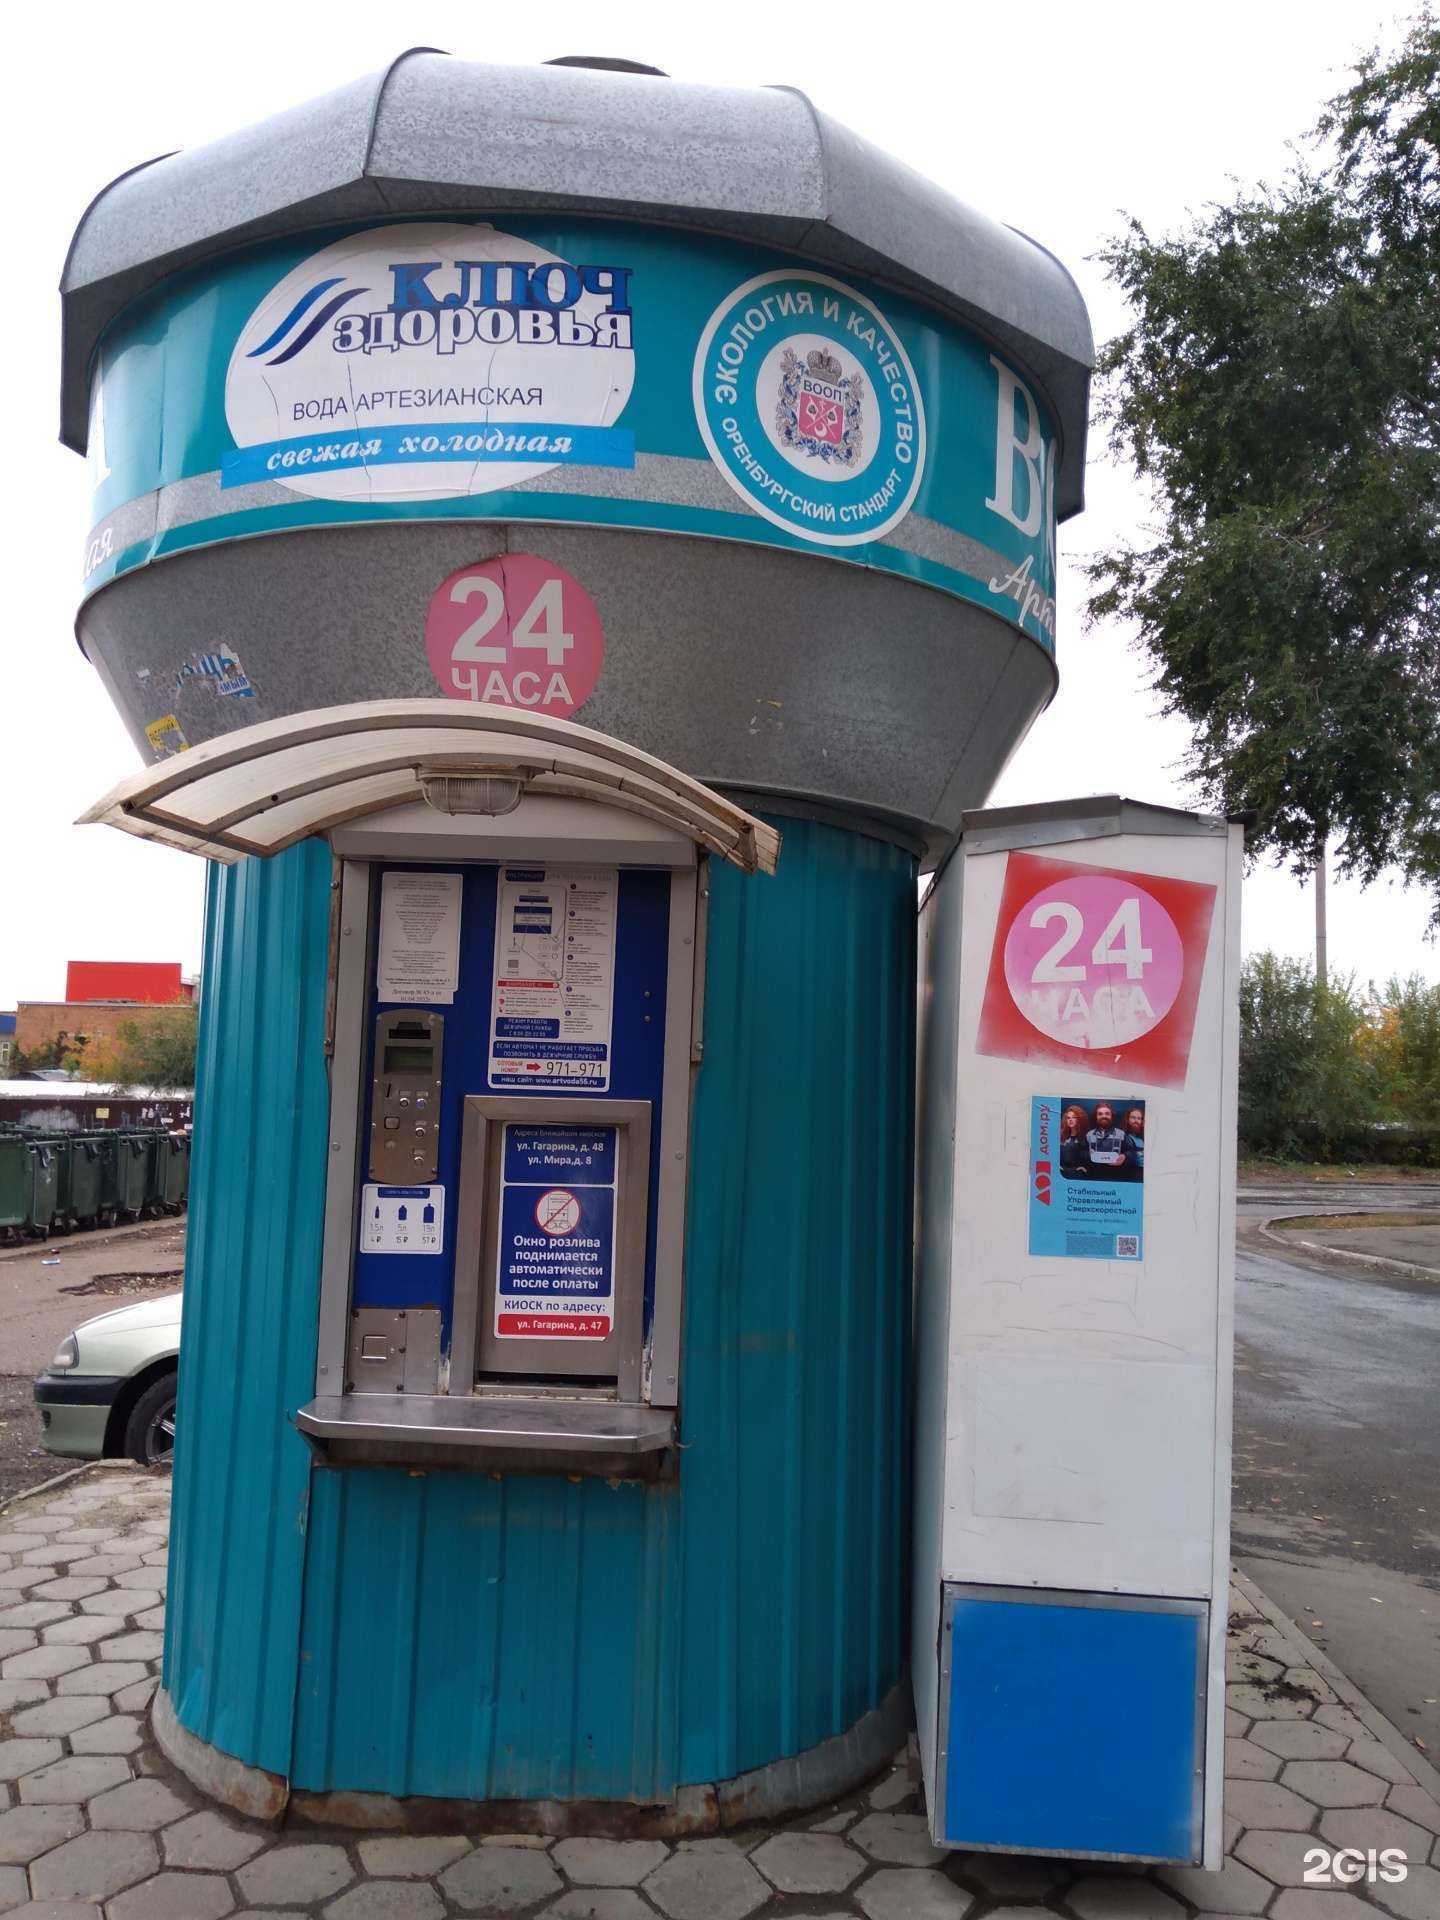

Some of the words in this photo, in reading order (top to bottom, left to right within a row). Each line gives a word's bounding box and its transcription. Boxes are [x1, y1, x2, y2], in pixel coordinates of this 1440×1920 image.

[388, 260, 634, 312] КЛЮЧ
[332, 307, 634, 355] здоровья
[715, 291, 814, 405] ЭКОЛОГИЯ
[822, 296, 839, 323] И
[846, 310, 913, 464] КАЧЕСТВО
[803, 379, 843, 403] ВООП
[293, 398, 348, 421] ВОДА
[355, 387, 543, 412] АРТЕЗИАНСКАЯ
[265, 433, 383, 472] свежая
[397, 428, 573, 455] холодная
[722, 417, 836, 522] ОРЕНБУРГСКИЙ
[839, 468, 902, 523] СТАНДАРТ
[450, 575, 574, 666] 24
[451, 667, 574, 705] ЧАСА
[1029, 898, 1153, 984] 24
[546, 1062, 603, 1077] 971-971
[535, 1077, 597, 1085] www.artvoda56.ru
[516, 1142, 530, 1151] ул.
[533, 1141, 578, 1152] Гагарина,
[580, 1143, 589, 1153] д.
[592, 1142, 604, 1152] 48
[528, 1155, 541, 1165] ул.
[585, 1156, 592, 1165] 8
[1067, 1187, 1117, 1197] Стабильный
[1066, 1196, 1122, 1206] Управляемый
[1066, 1205, 1137, 1215] Сверхскоростной
[513, 1235, 546, 1247] Окно
[549, 1238, 600, 1251] розлива
[515, 1251, 598, 1263] поднимается
[509, 1264, 603, 1276] автоматически
[512, 1278, 549, 1289] после
[552, 1279, 599, 1290] оплаты
[504, 1300, 543, 1311] КИОСК
[546, 1303, 559, 1312] по
[562, 1303, 606, 1314] адресу:
[517, 1320, 530, 1330] ул.
[533, 1319, 577, 1331] Гагарина,
[579, 1321, 588, 1331] д.
[591, 1321, 602, 1330] 47
